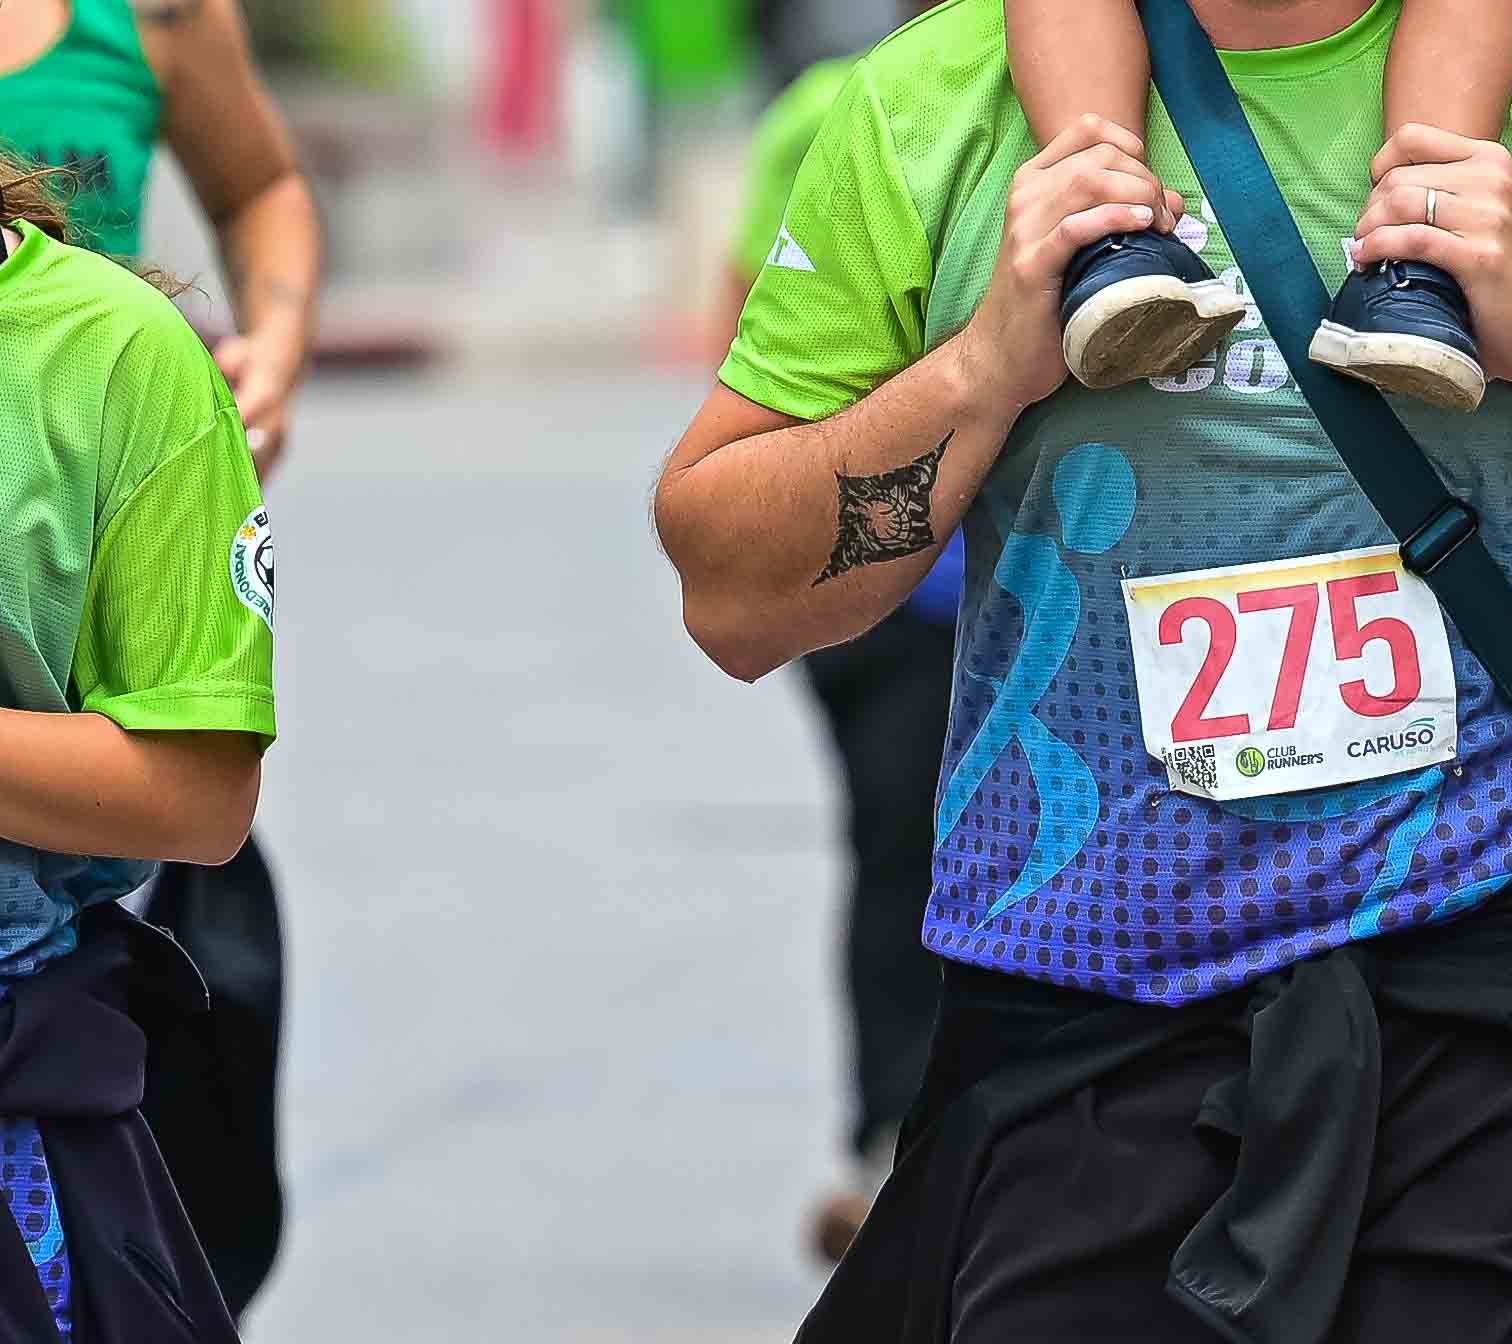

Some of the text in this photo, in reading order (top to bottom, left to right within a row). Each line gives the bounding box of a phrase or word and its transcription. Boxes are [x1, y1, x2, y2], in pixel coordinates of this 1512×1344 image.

[1158, 571, 1422, 743] 275
[1267, 745, 1297, 759] CLUB
[1347, 729, 1434, 758] CARUSO
